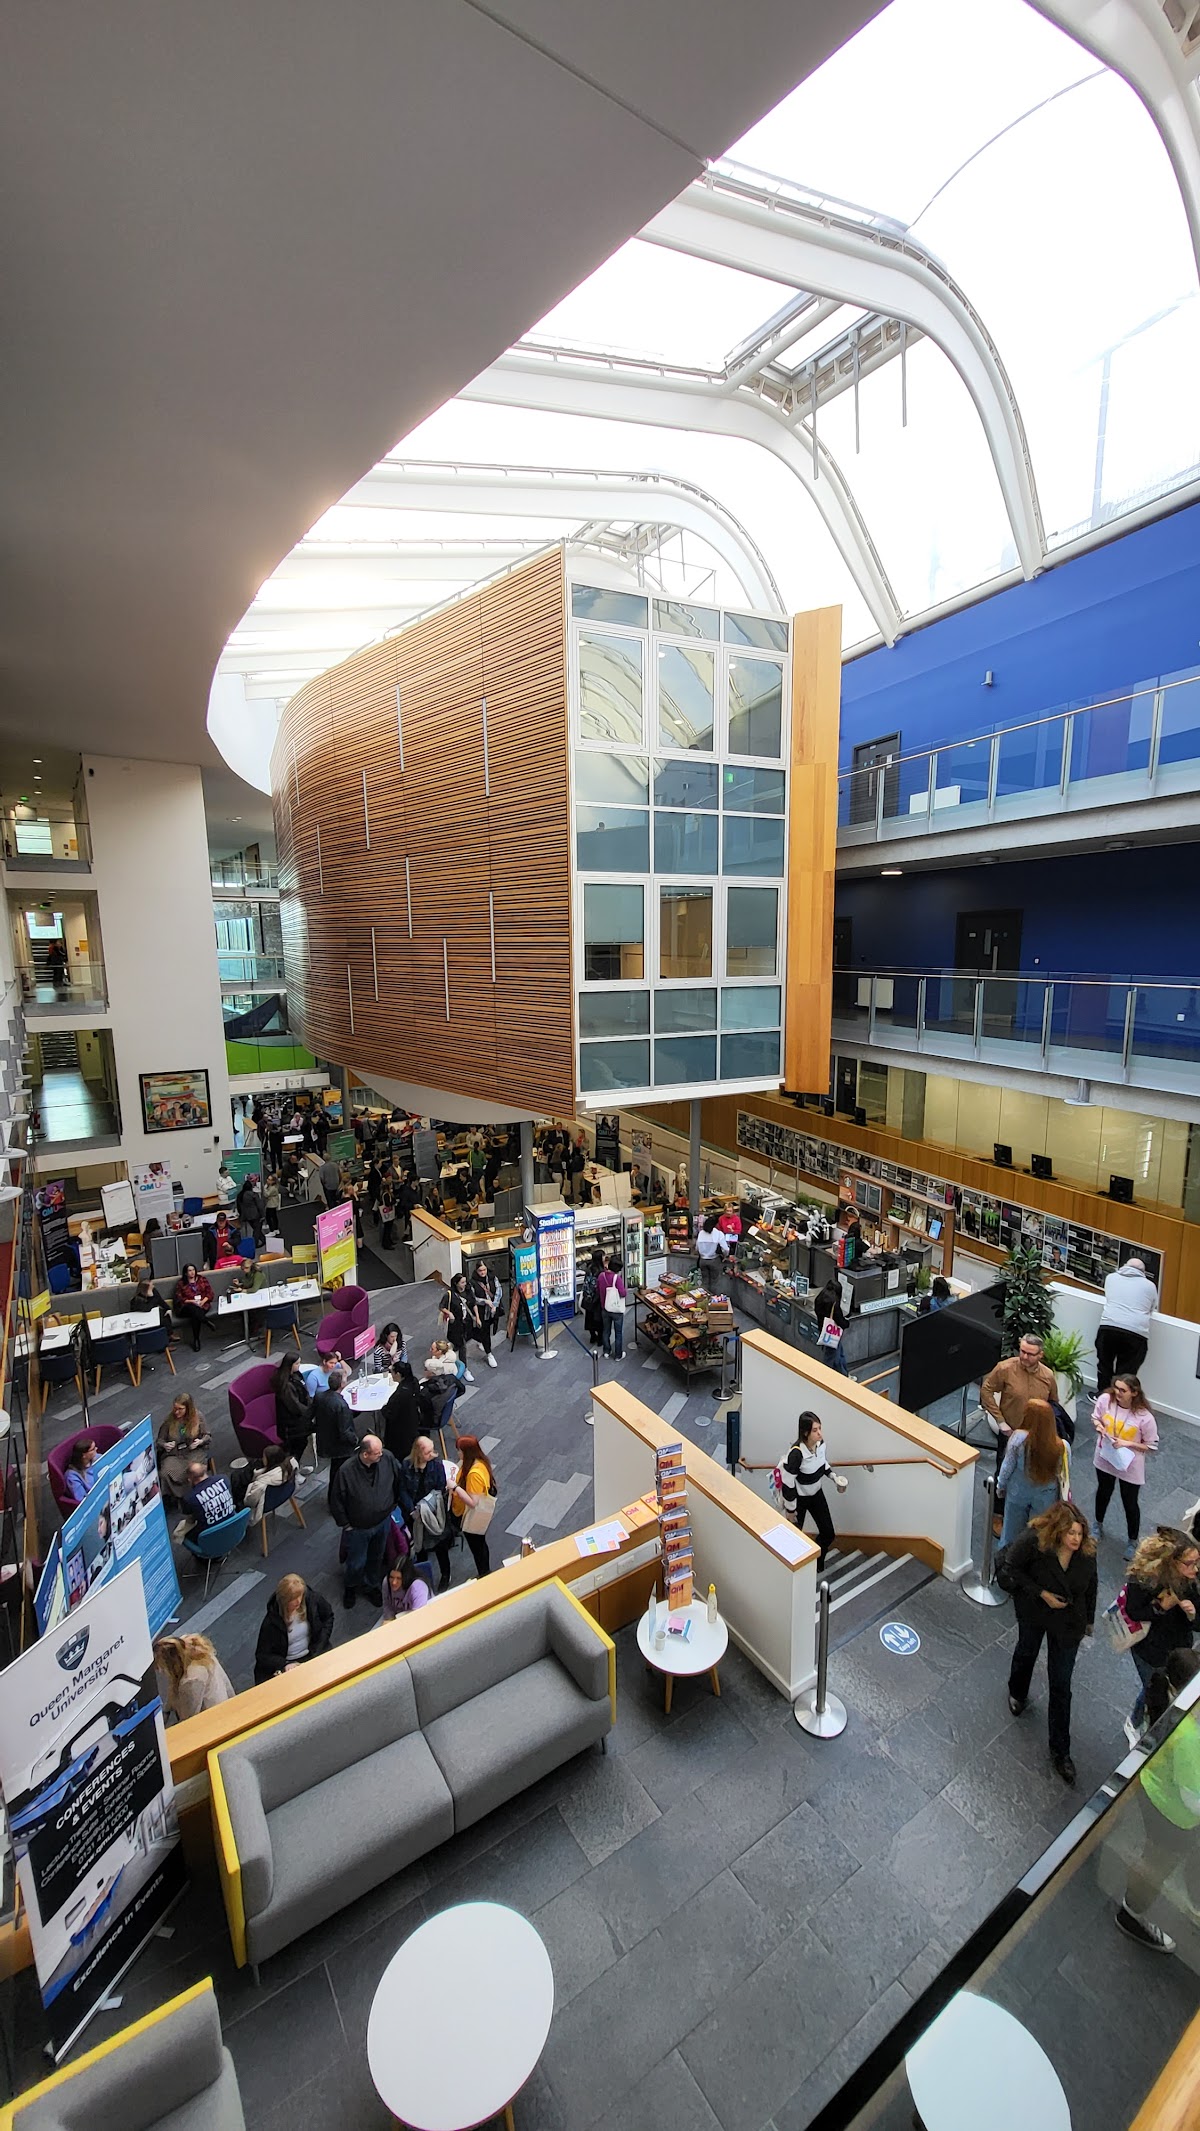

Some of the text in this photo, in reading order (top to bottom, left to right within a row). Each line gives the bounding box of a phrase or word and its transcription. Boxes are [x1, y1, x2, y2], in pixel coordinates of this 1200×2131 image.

[538, 1215, 574, 1227] Strathmore
[864, 1299, 891, 1311] Collection
[195, 1478, 228, 1504] MONT
[204, 1497, 234, 1519] CYCLING
[206, 1505, 234, 1525] CLUB
[29, 1635, 125, 1727] Queen Margaret
[51, 1662, 110, 1721] University
[41, 1844, 69, 1878] Lecture
[69, 1809, 99, 1844] Theatres
[103, 1774, 132, 1806] Seminar
[131, 1749, 155, 1776] Rooms
[56, 1740, 136, 1830] CONFERENCES
[71, 1766, 123, 1827] & EVENTS
[41, 1839, 82, 1888] Conference
[81, 1818, 99, 1841] Suite
[104, 1778, 137, 1813] Exhibition
[136, 1756, 158, 1780] Space
[78, 1804, 129, 1865] 0131 474 0000
[73, 1924, 124, 1993] Excellence
[134, 1873, 164, 1912] Events
